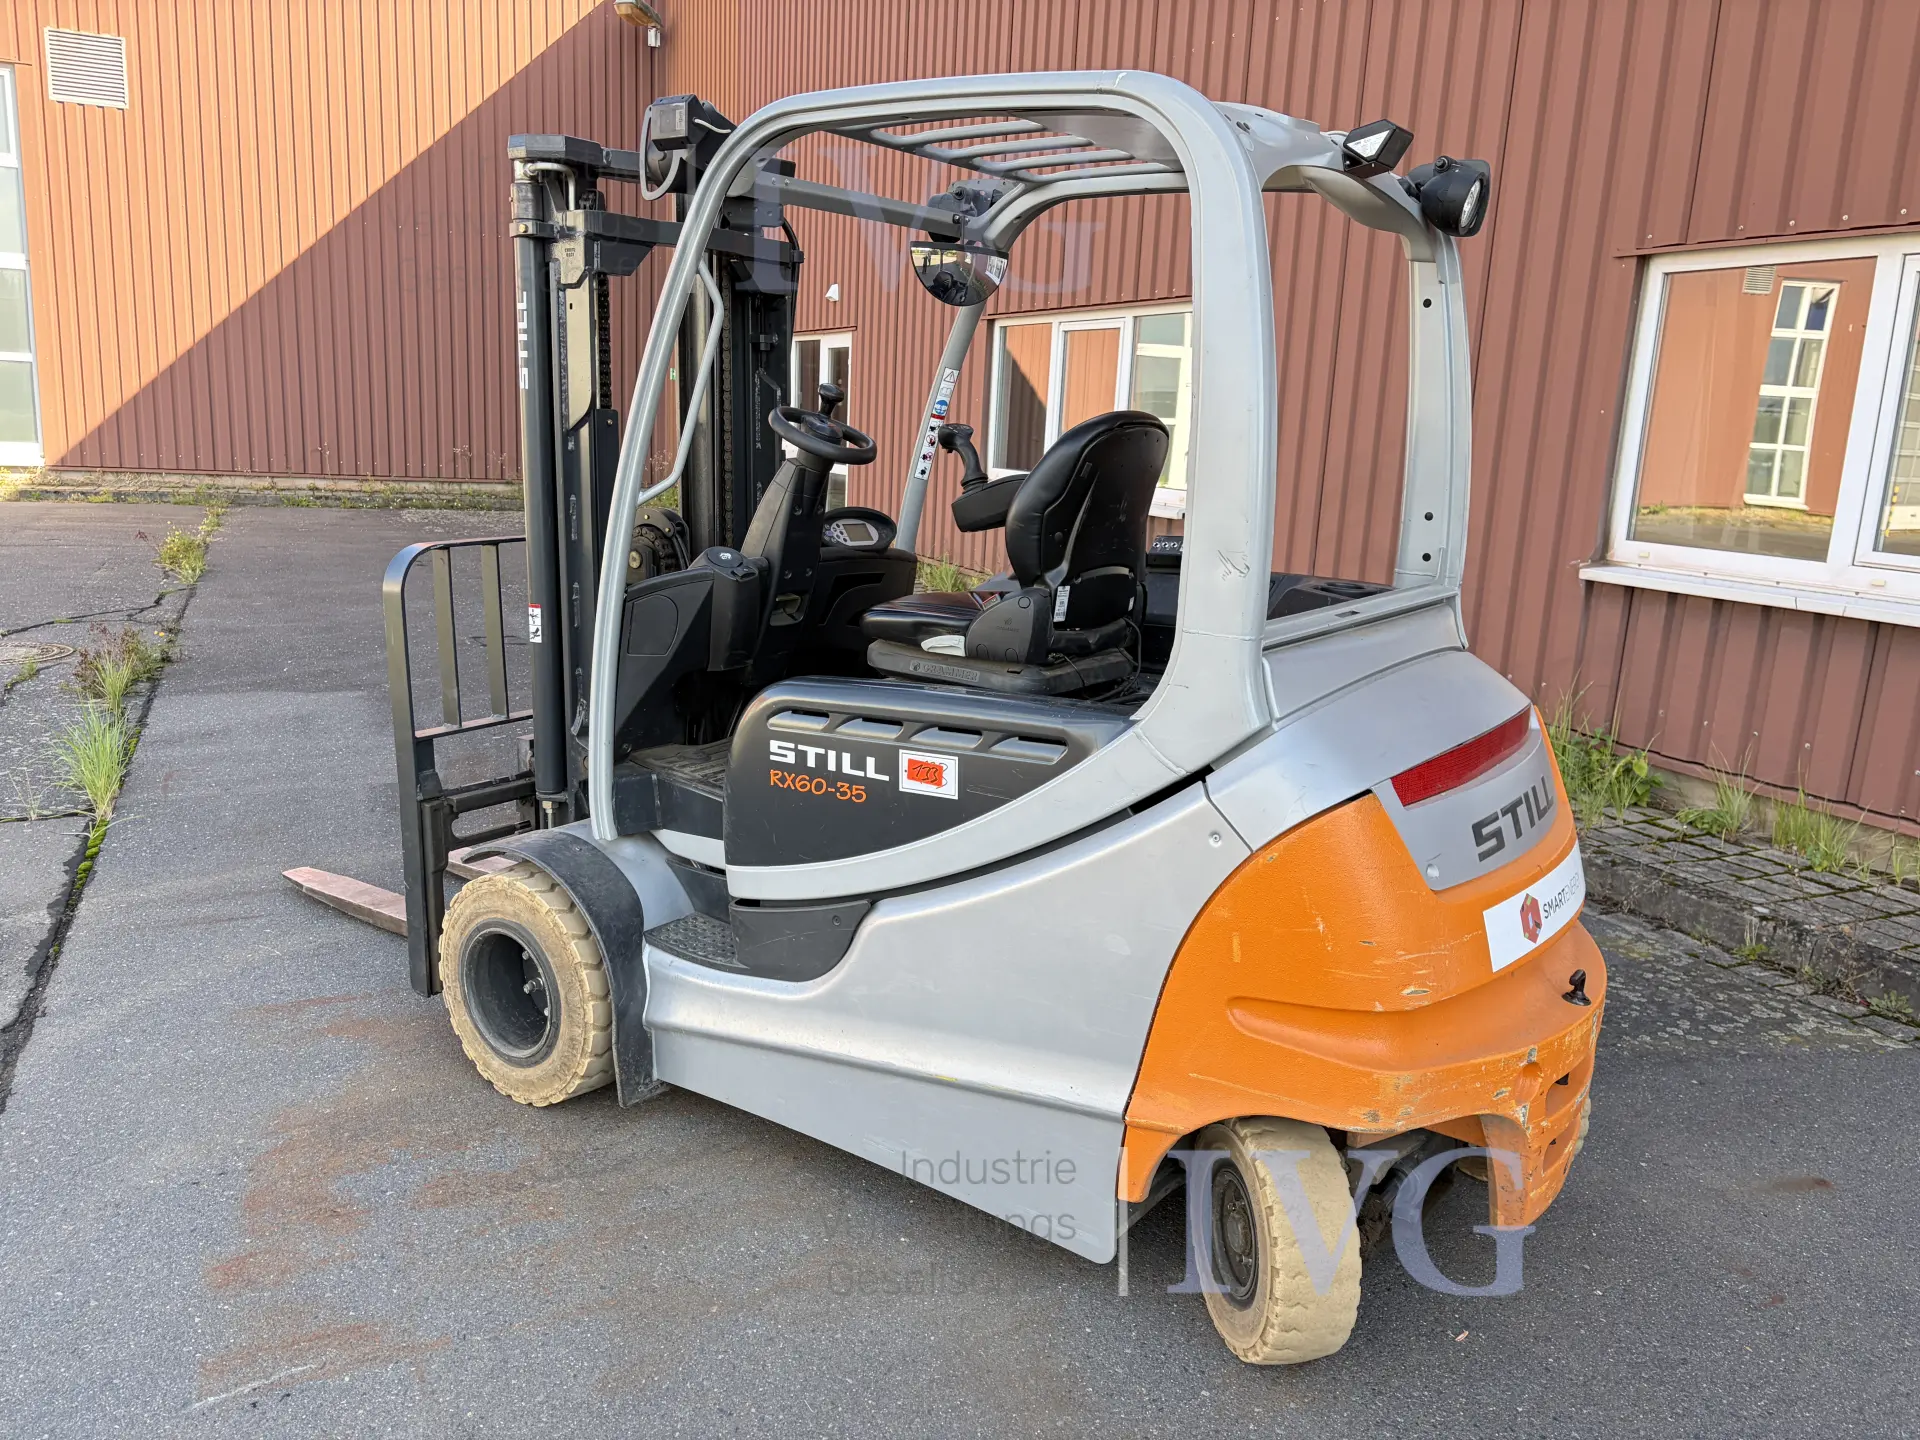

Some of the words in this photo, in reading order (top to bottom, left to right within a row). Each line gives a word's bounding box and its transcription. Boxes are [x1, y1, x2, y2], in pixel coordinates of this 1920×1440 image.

[769, 739, 890, 782] STILL
[769, 769, 867, 803] RX60-35
[1470, 775, 1555, 863] STILL
